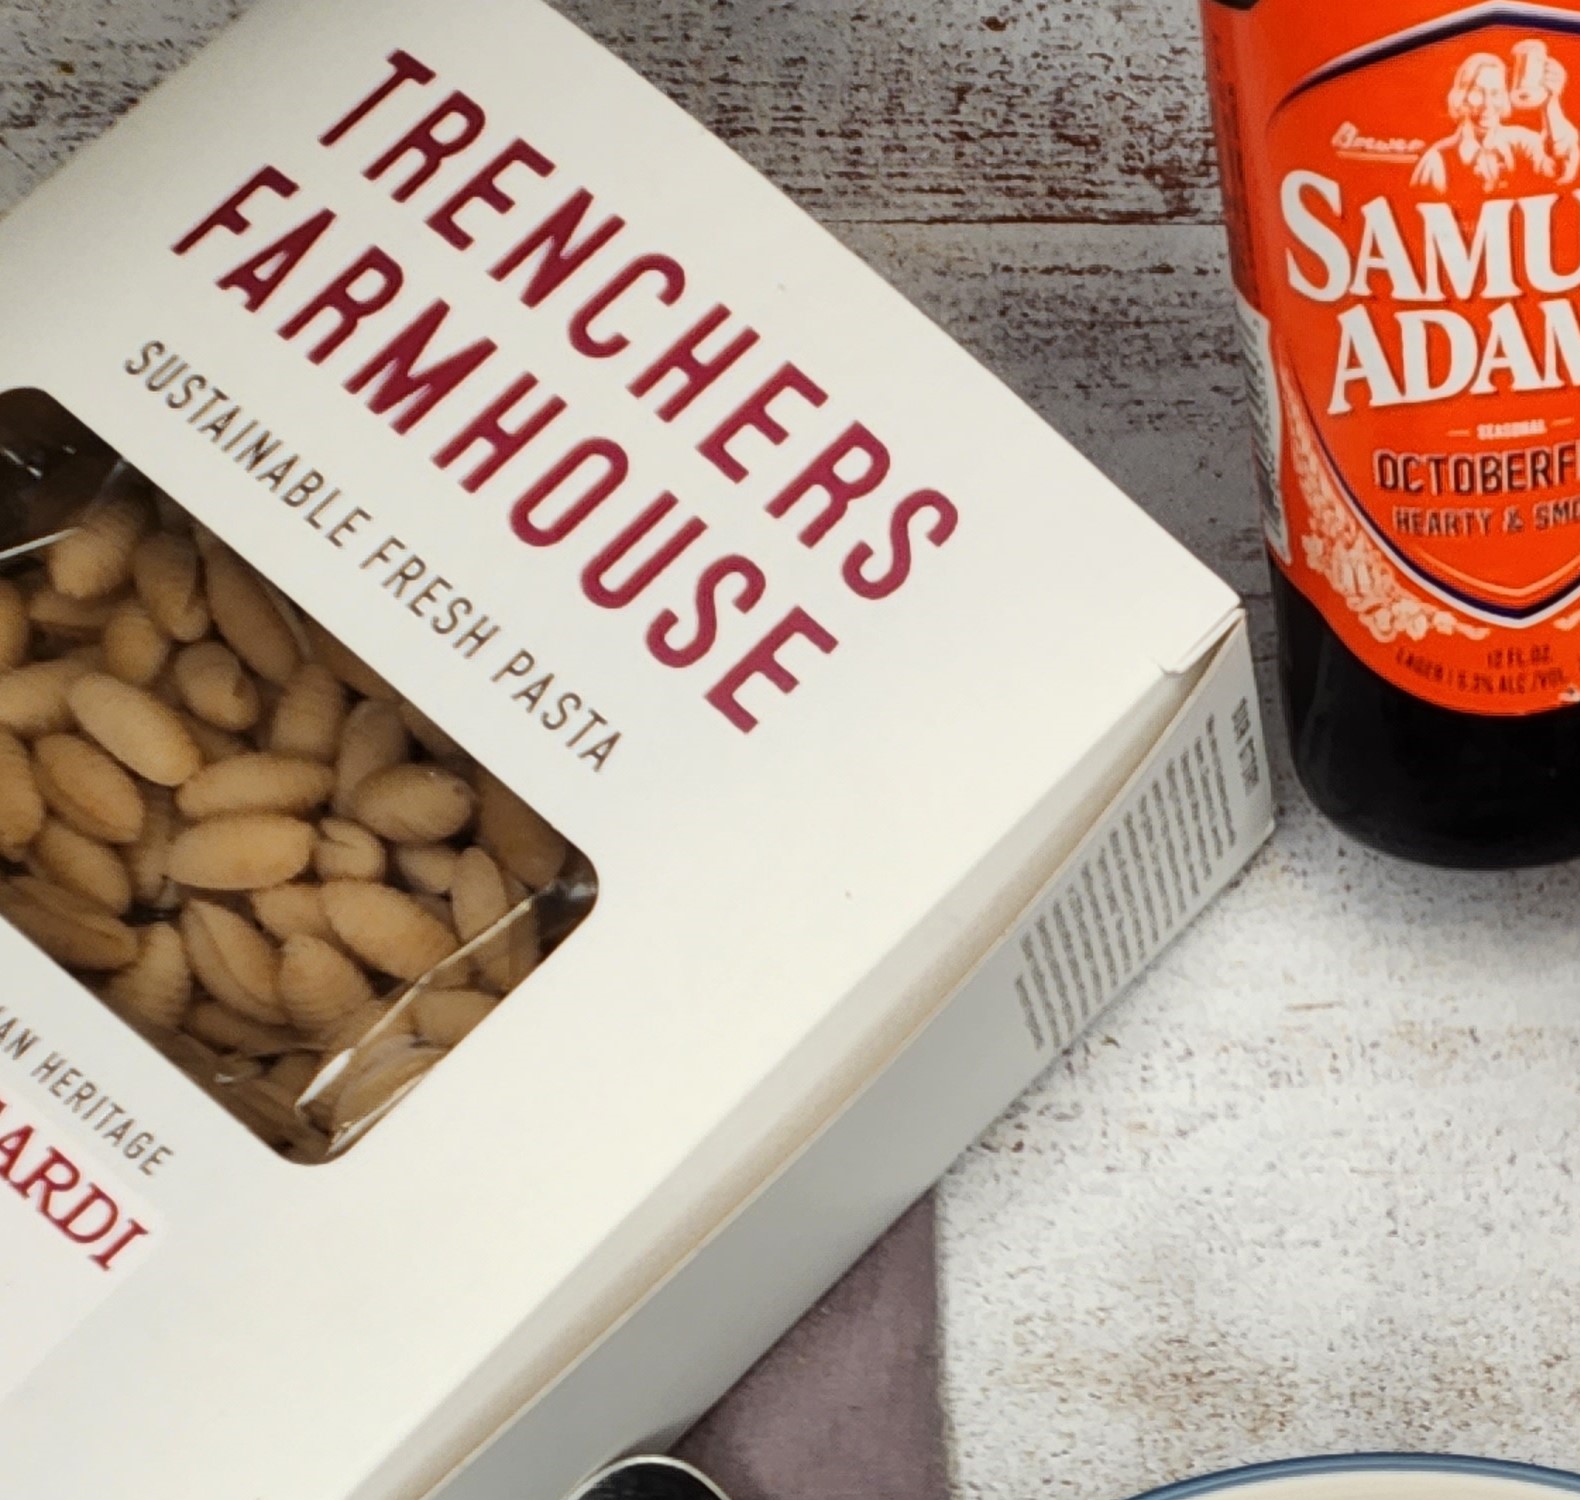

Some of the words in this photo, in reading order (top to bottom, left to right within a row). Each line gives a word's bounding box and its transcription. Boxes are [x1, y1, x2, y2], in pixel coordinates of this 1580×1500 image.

[171, 165, 840, 733] FARMHOUSE
[319, 49, 959, 600] TRENCHERS
[125, 340, 373, 549] SUSTAINABLE
[360, 535, 503, 660] FRESH
[491, 648, 622, 773] PASTA
[1393, 506, 1493, 537] HEARTY
[1502, 504, 1523, 534] &
[0, 1003, 38, 1060] AN
[29, 1051, 175, 1175] HERITAGE
[0, 1097, 149, 1272] ARDI
